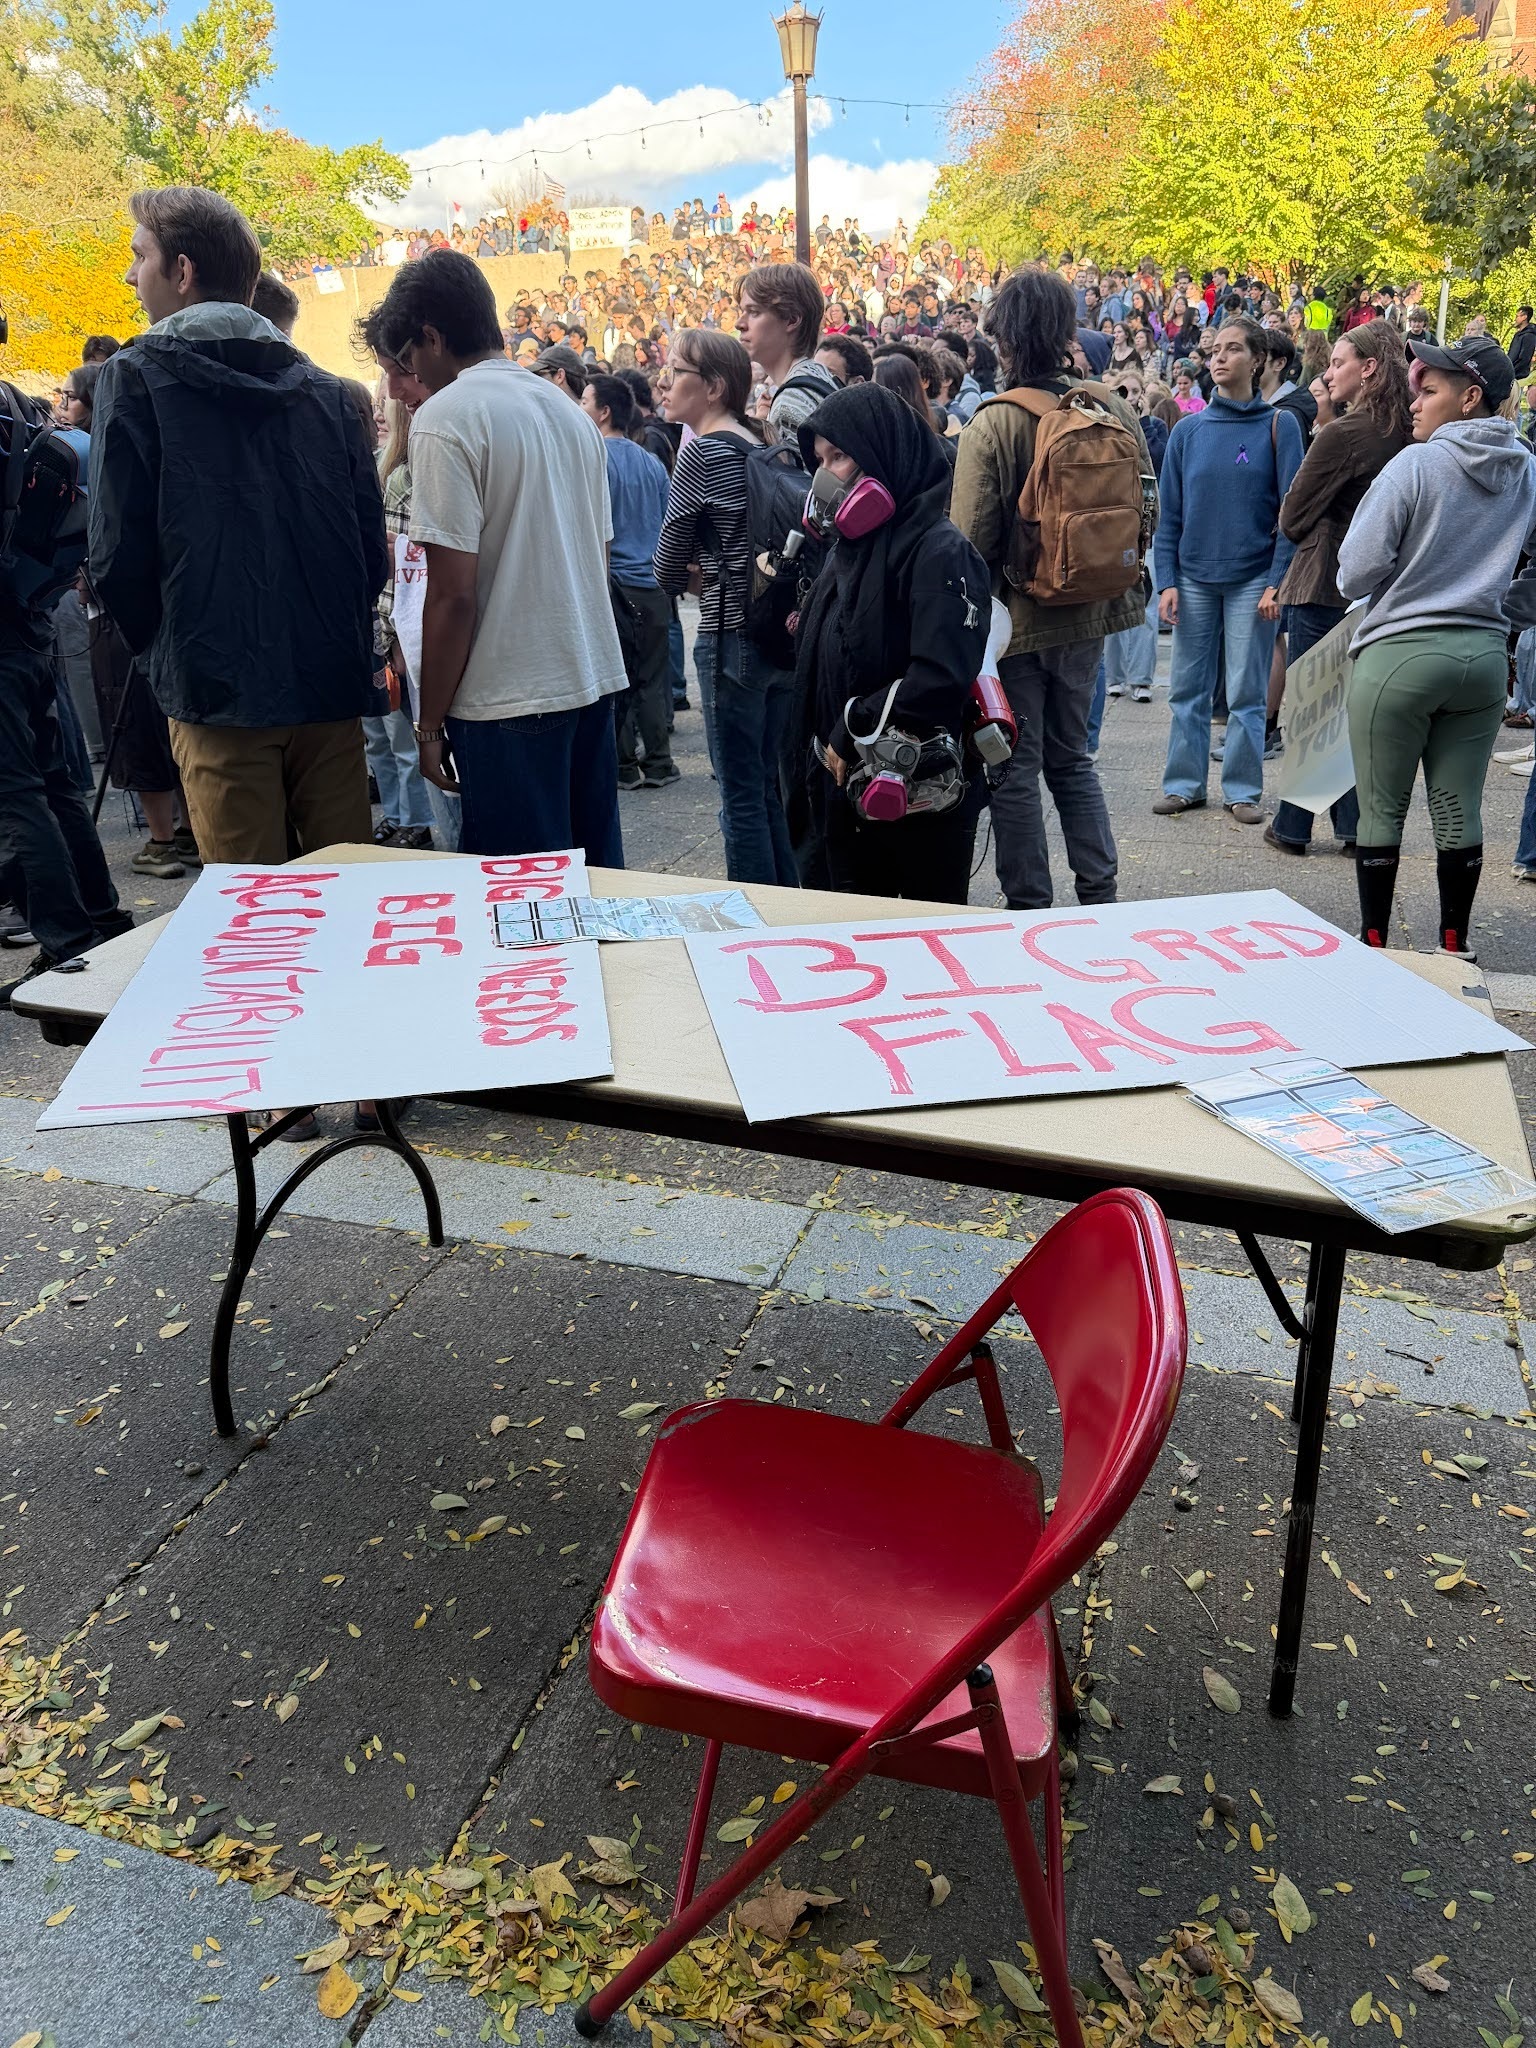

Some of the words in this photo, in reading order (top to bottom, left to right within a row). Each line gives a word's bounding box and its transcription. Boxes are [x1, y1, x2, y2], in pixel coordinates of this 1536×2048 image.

[481, 855, 571, 902] BIG
[363, 892, 464, 967] BIG
[719, 918, 1162, 1013] BIG
[1130, 920, 1343, 973] RED
[77, 872, 340, 1112] ACCOUNTABILITY
[474, 958, 580, 1047] NEEDS
[839, 986, 1304, 1094] FLAG
